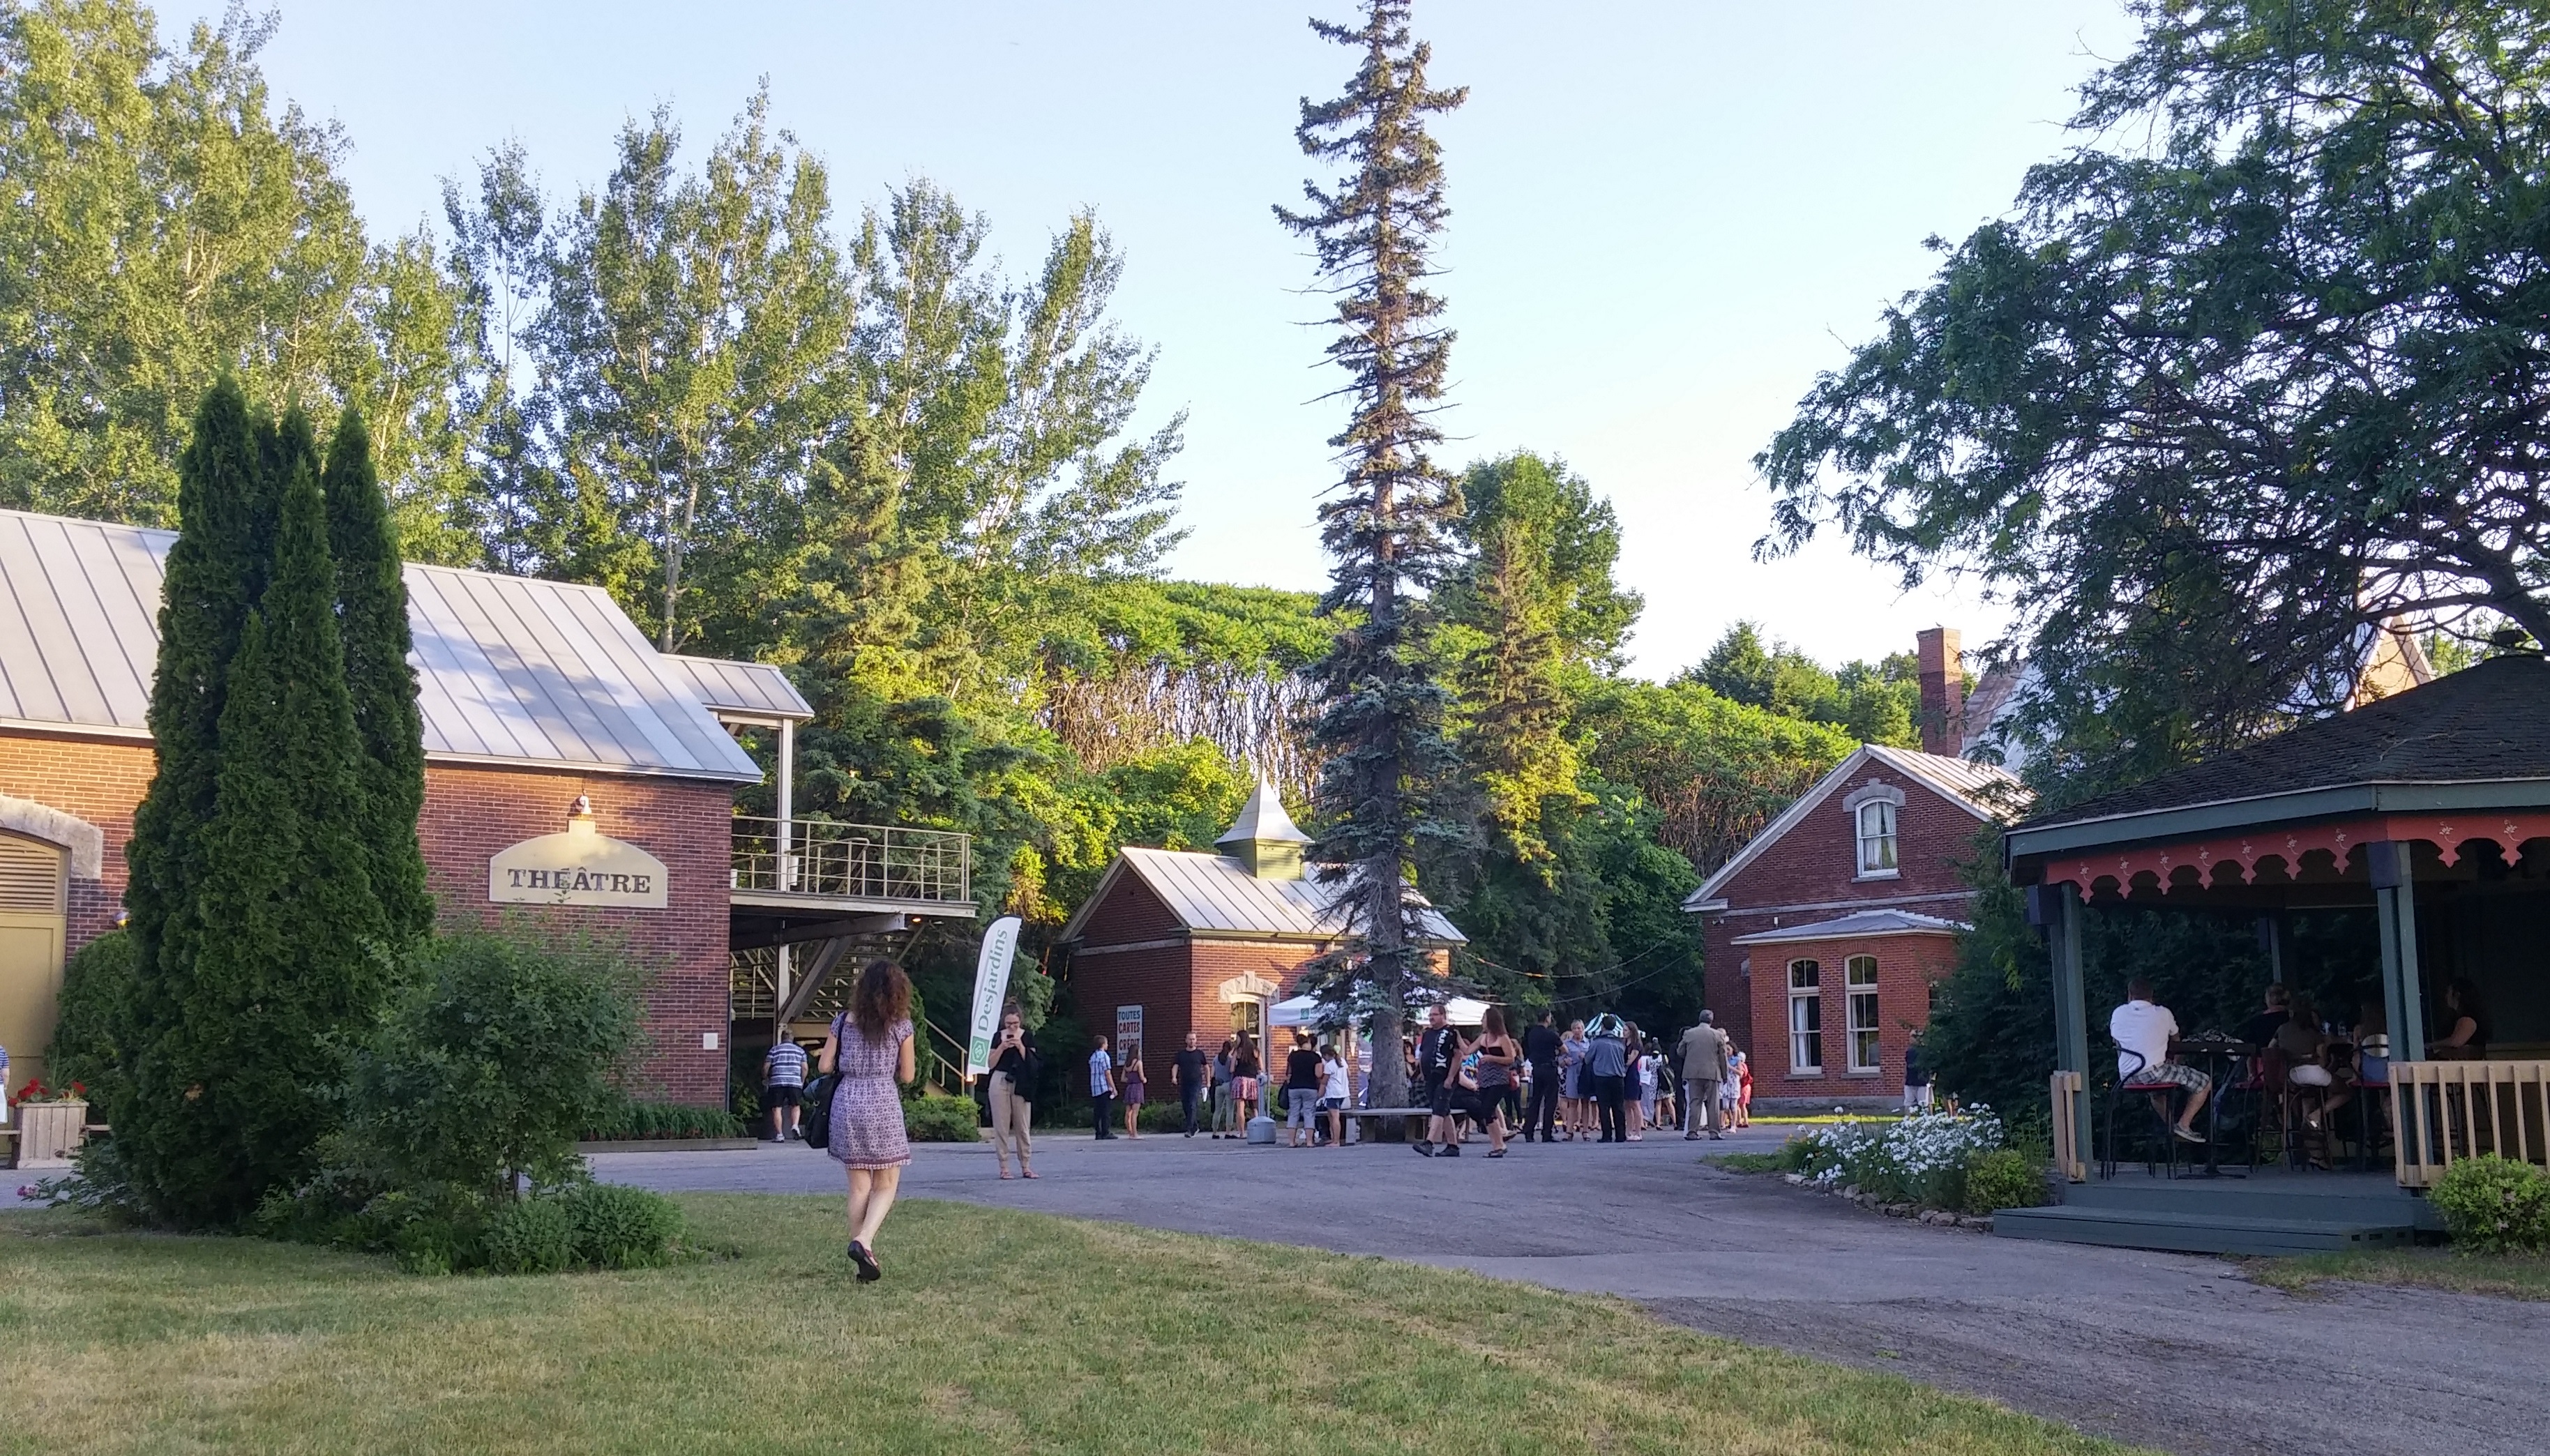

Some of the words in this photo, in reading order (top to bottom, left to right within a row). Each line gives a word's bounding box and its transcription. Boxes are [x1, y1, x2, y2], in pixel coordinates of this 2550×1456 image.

[507, 866, 651, 894] THÉÂTRE
[978, 929, 1007, 1032] Desjardins
[1118, 1010, 1140, 1020] TOUTES
[1118, 1022, 1140, 1034] CARTES
